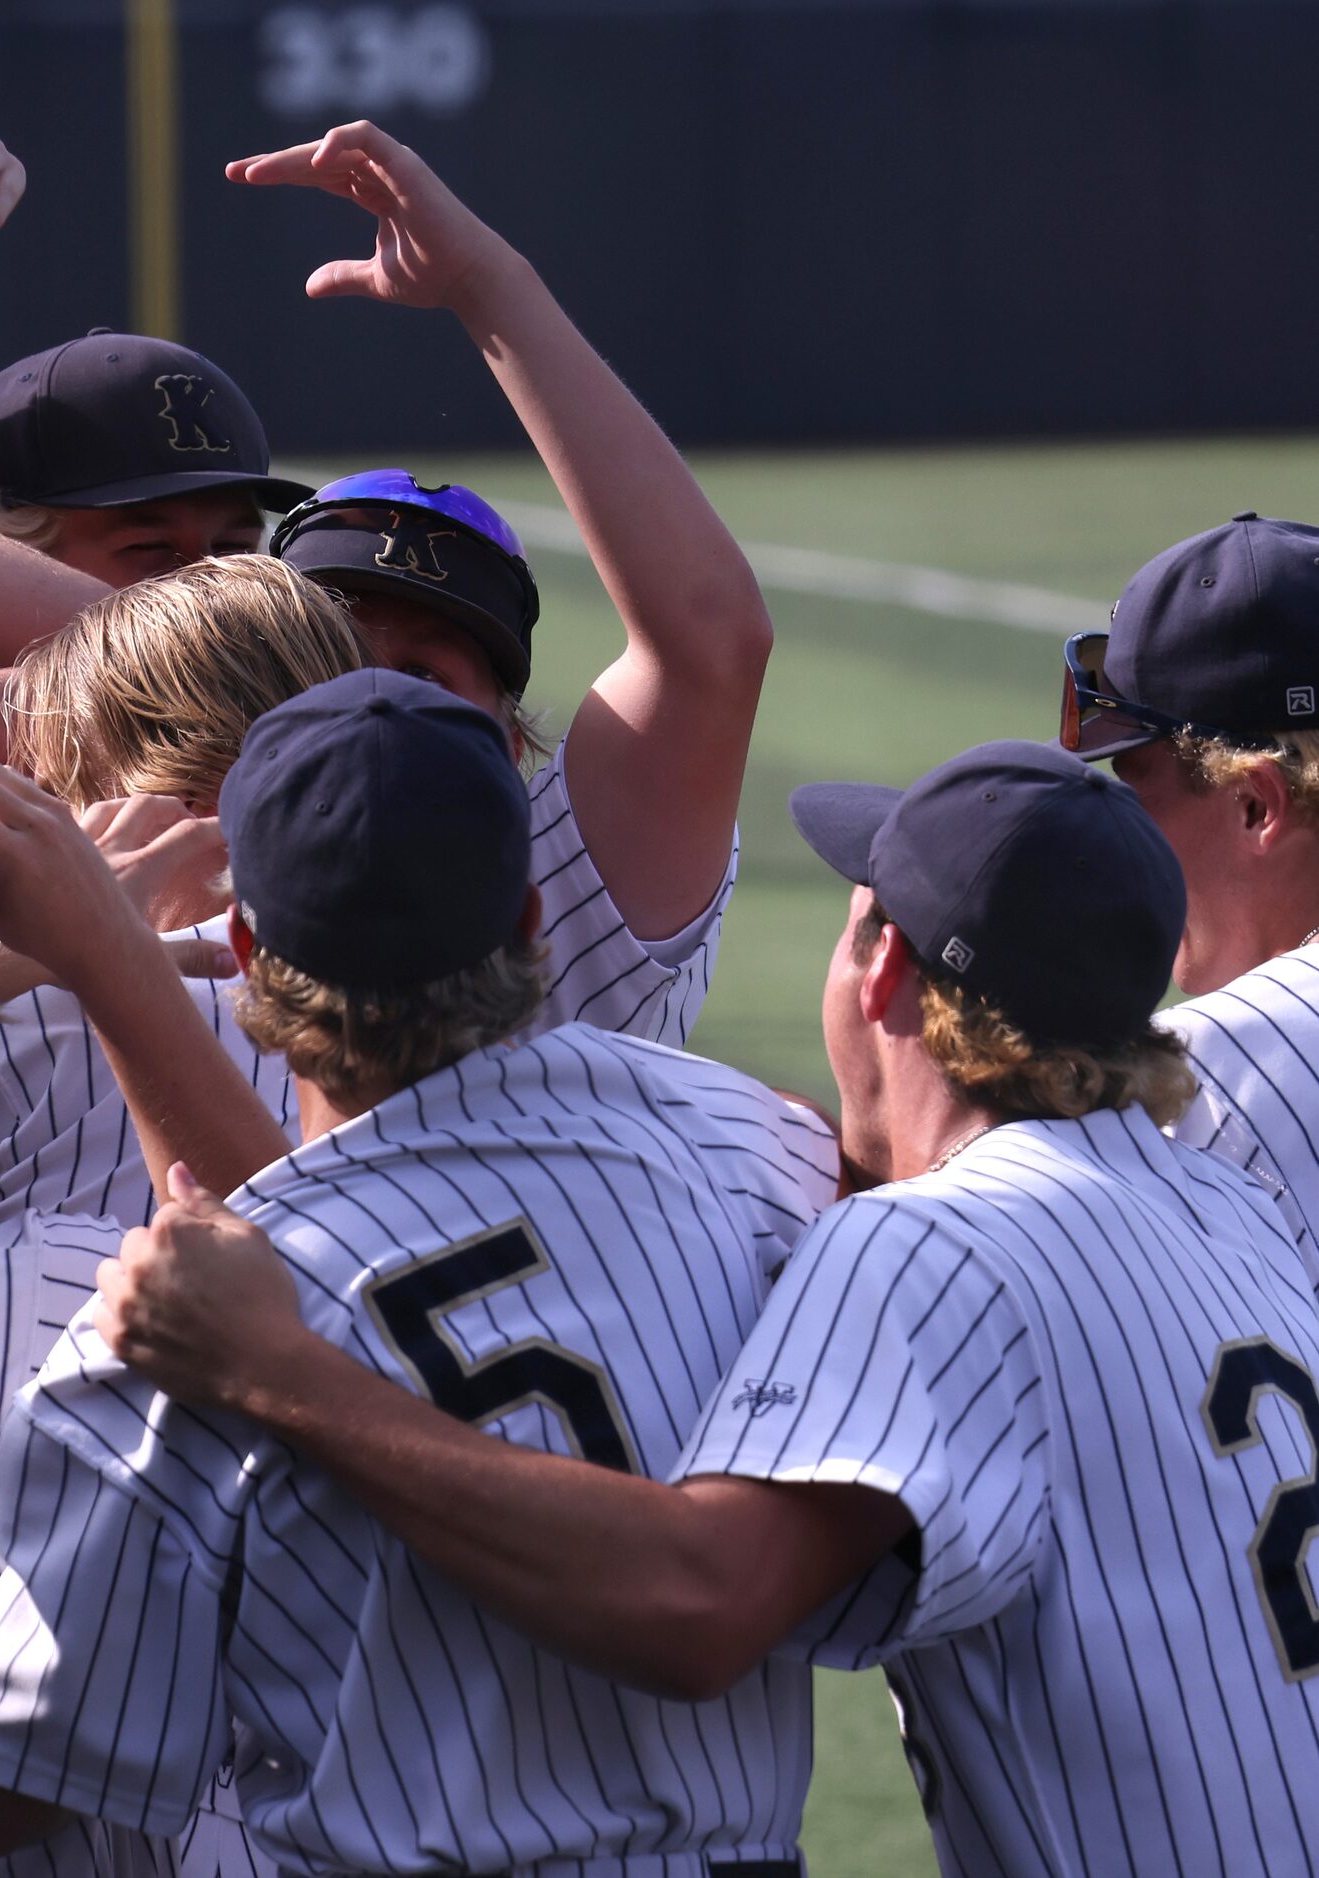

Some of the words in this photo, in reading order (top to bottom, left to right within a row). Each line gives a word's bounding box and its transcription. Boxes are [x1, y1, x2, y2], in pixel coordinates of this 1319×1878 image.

[258, 8, 488, 113] 330
[154, 373, 233, 453] K
[374, 509, 458, 581] K
[362, 1215, 642, 1477] 5
[1199, 1333, 1319, 1684] 2
